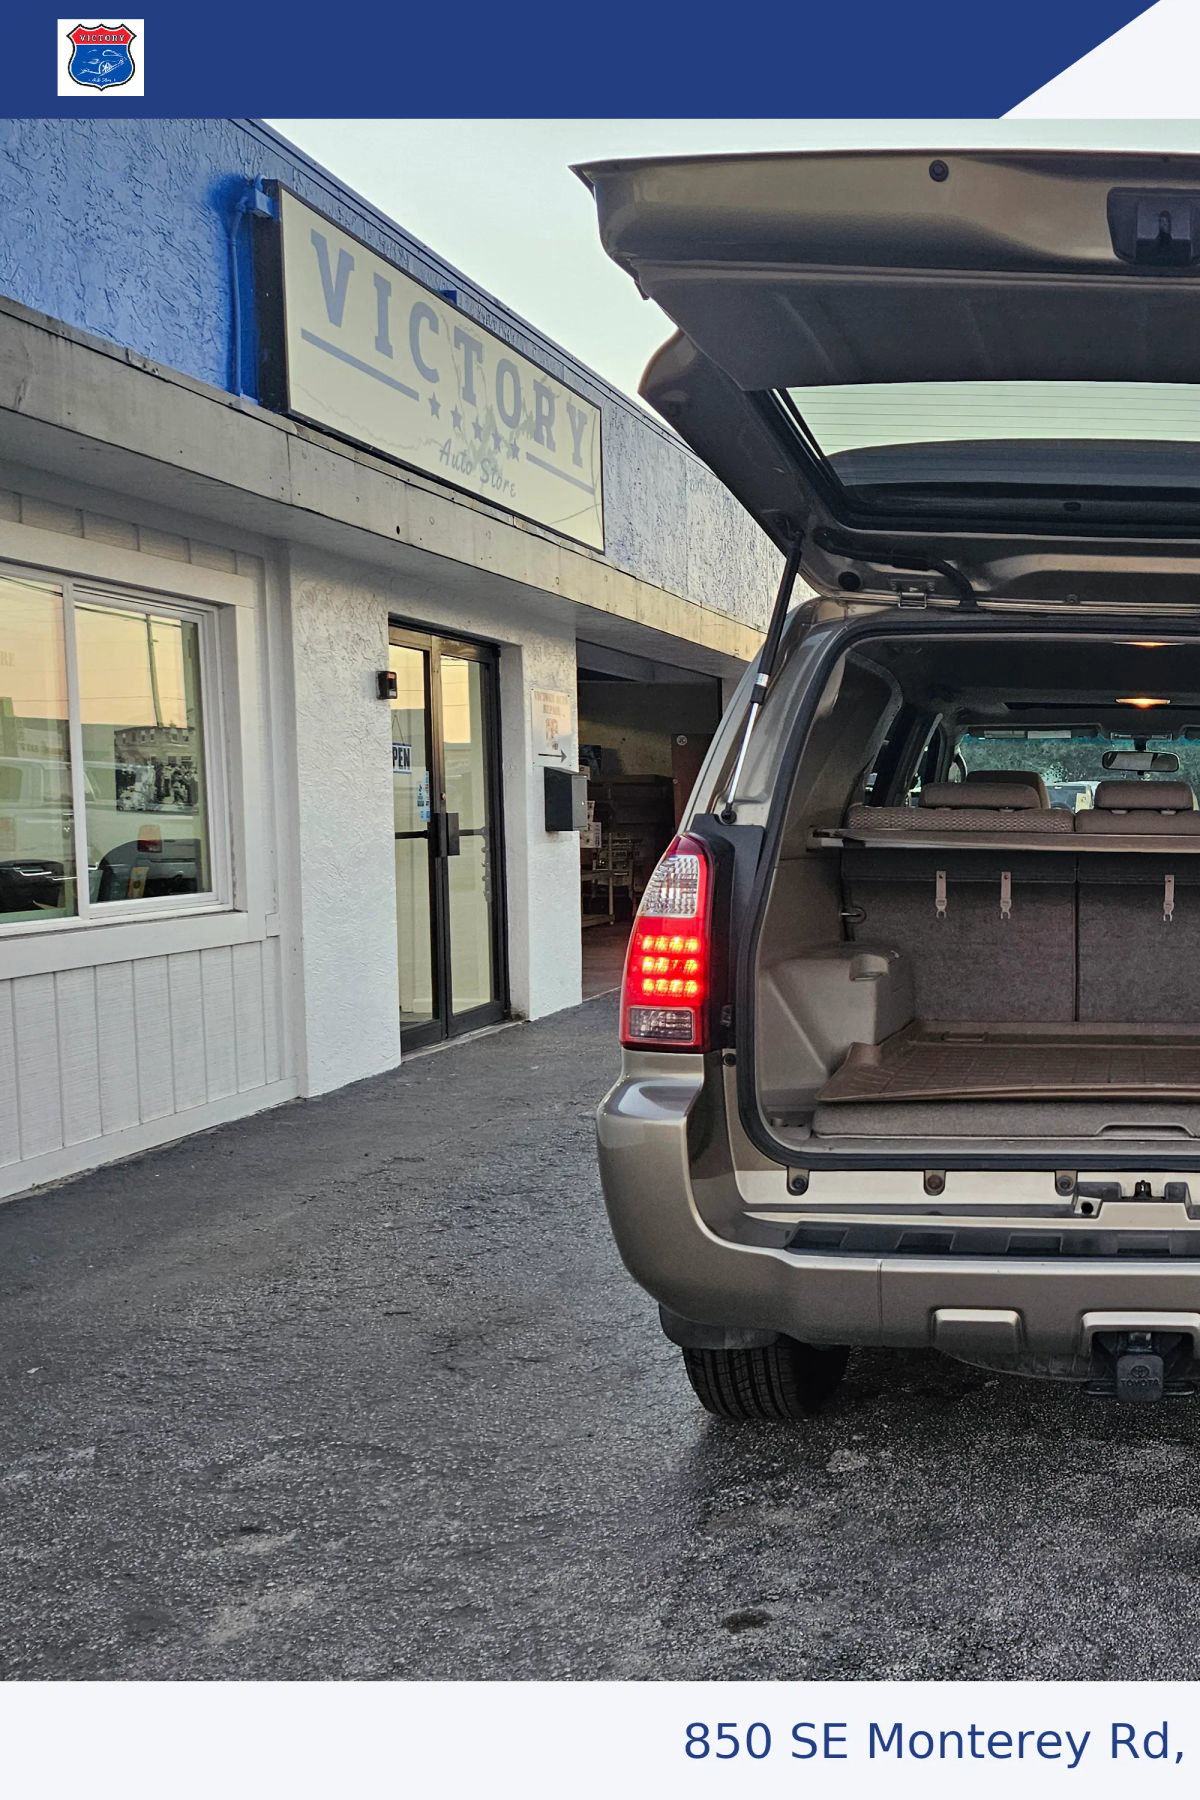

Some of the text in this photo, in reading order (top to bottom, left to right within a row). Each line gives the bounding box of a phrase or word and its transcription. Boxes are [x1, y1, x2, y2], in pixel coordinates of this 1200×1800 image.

[310, 228, 589, 469] VICTORY
[439, 438, 516, 498] Auto Store
[392, 746, 410, 769] PEN
[1120, 1379, 1160, 1388] TOYOTA
